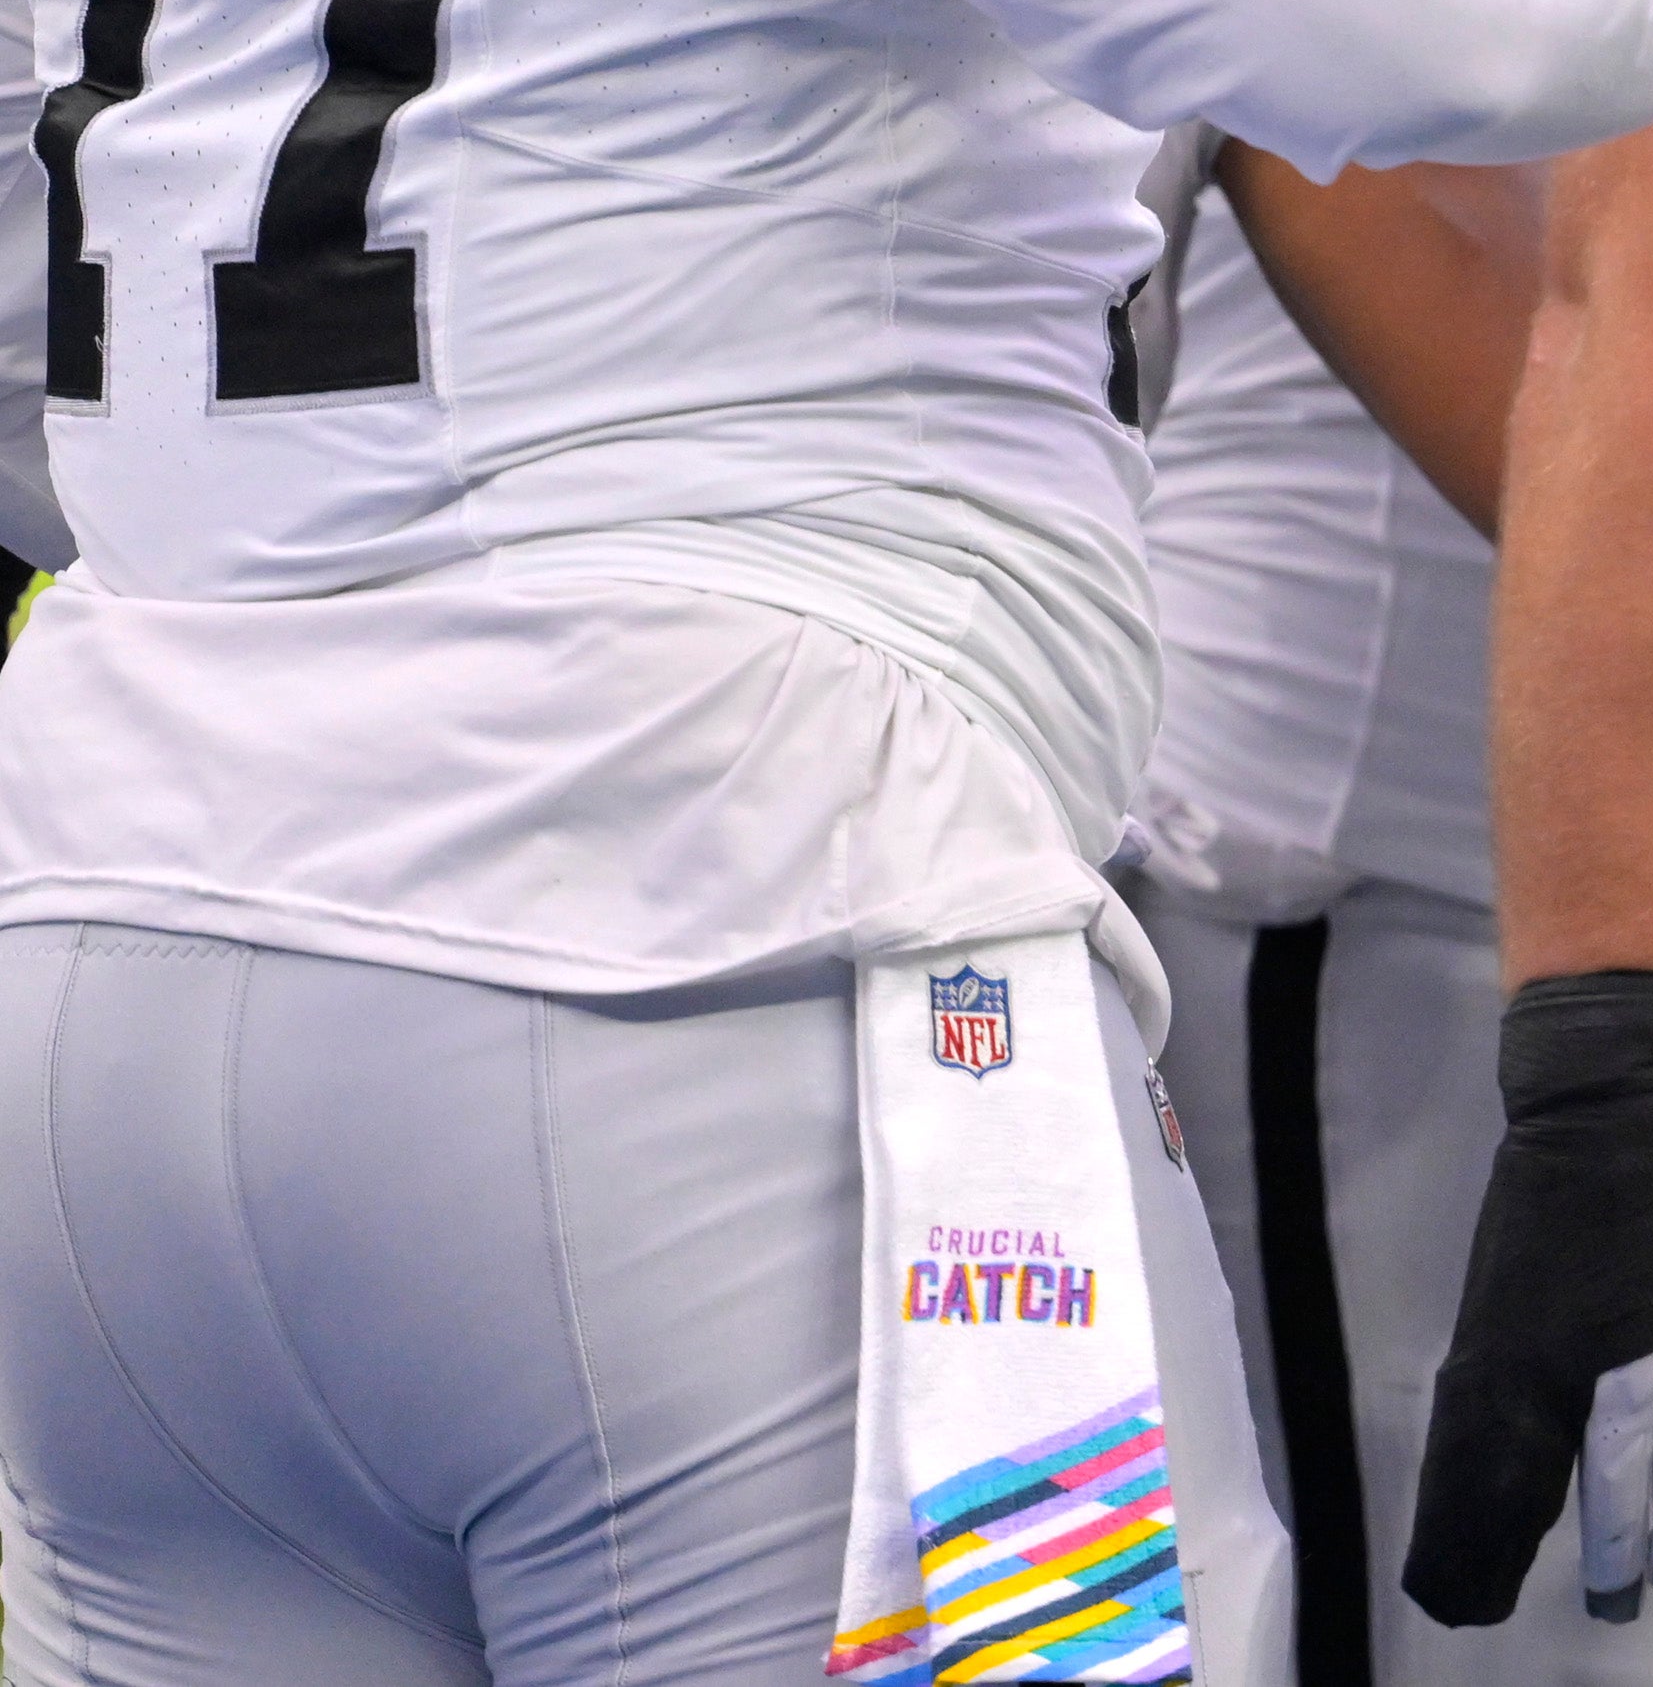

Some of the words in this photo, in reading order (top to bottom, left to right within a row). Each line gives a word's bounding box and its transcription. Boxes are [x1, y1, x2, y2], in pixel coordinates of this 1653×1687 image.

[940, 1013, 1006, 1070] NFL
[929, 1225, 1066, 1258] CRUCIAL
[902, 1260, 1097, 1329] CATCH
